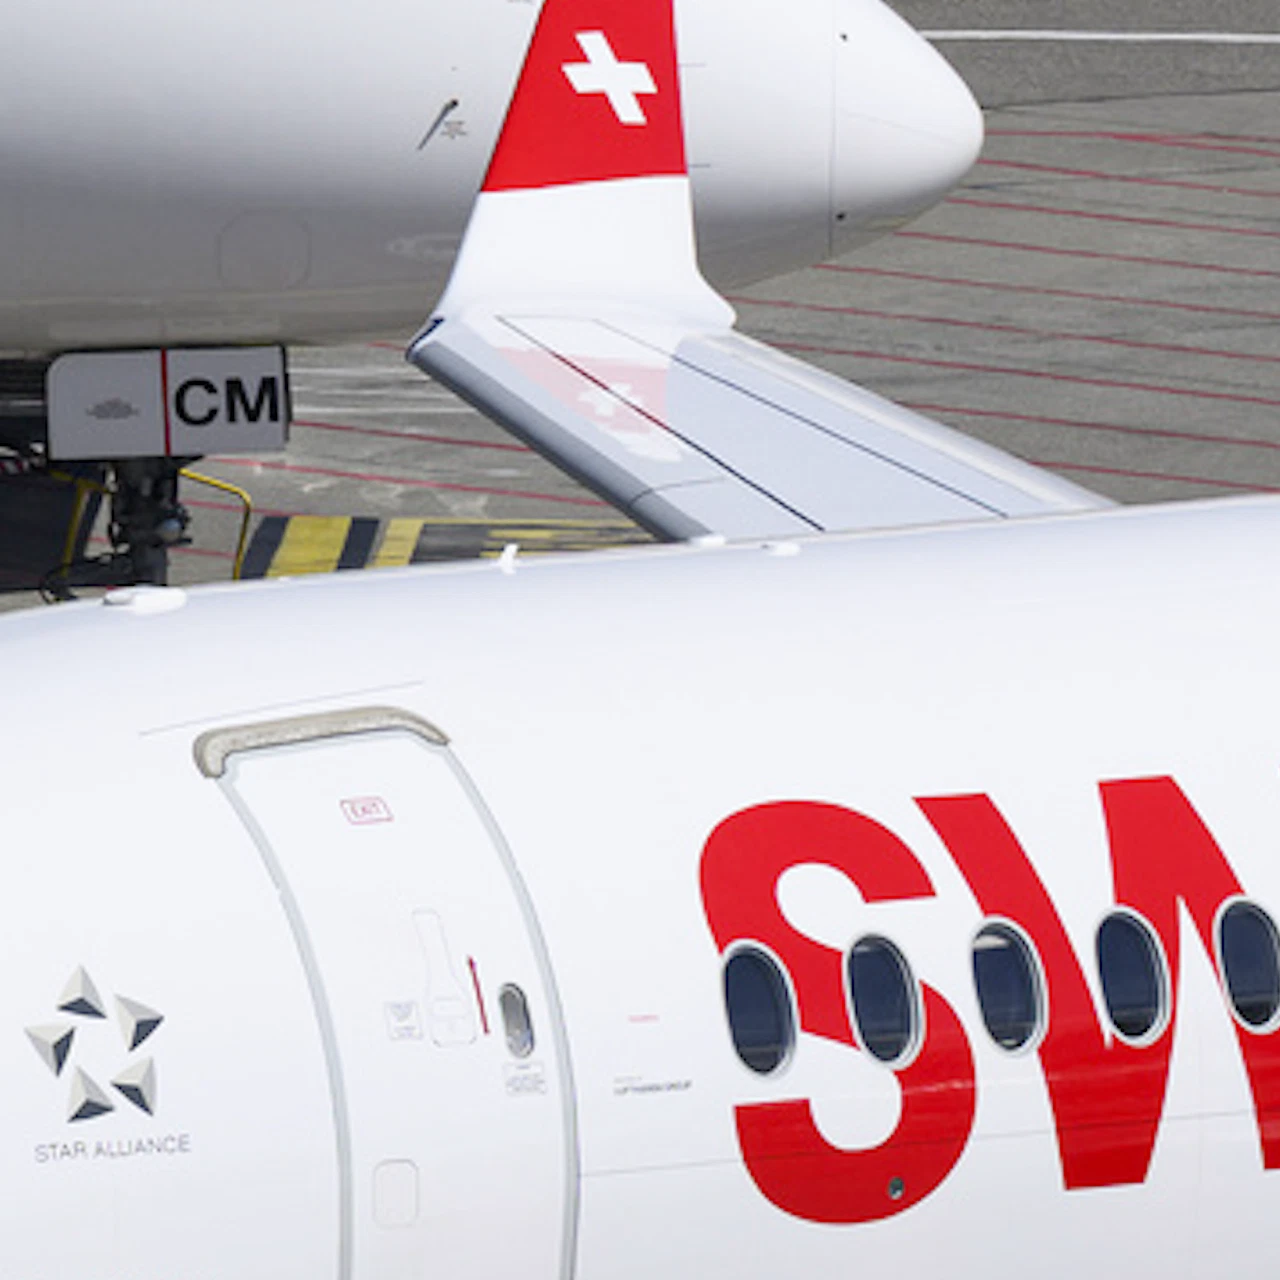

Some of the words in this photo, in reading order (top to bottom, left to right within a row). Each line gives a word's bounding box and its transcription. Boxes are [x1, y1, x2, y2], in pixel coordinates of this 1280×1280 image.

[174, 376, 280, 427] CM
[34, 1140, 88, 1163] STAR
[93, 1133, 191, 1159] ALLIANCE
